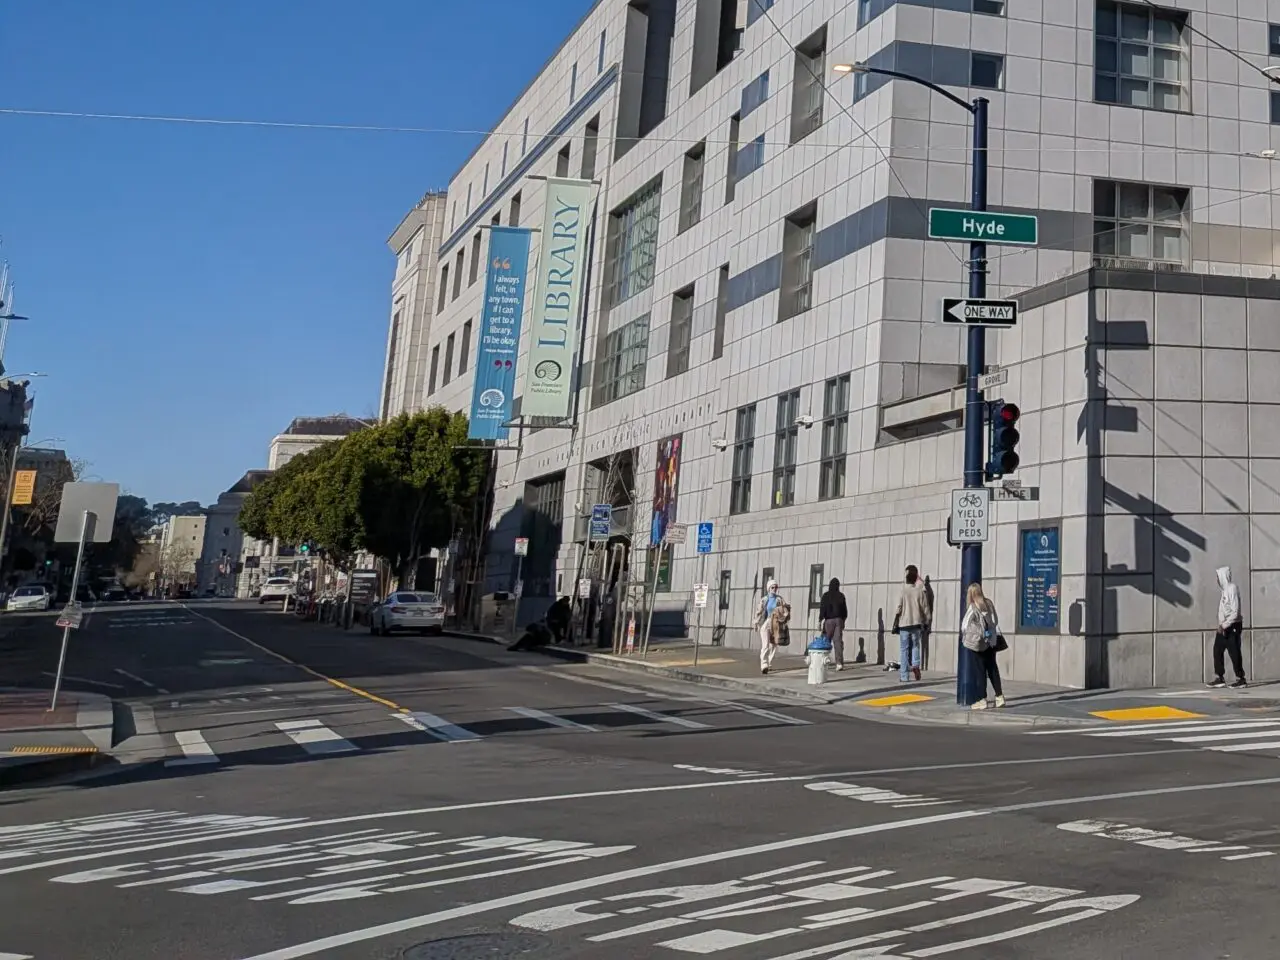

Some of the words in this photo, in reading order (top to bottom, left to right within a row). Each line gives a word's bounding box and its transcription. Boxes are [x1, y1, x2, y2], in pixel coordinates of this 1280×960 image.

[962, 218, 1005, 237] Hyde
[538, 195, 580, 350] LIBRARY
[497, 276, 520, 286] always
[496, 285, 508, 294] felt,
[488, 296, 501, 304] any
[501, 296, 520, 305] town,
[502, 306, 514, 314] can
[964, 306, 986, 318] ONE
[988, 306, 1011, 318] WAY
[489, 317, 501, 325] get
[502, 317, 510, 325] to
[491, 336, 500, 344] be
[500, 336, 516, 346] okay.
[998, 489, 1026, 500] HYDE
[957, 509, 984, 518] YIELD
[964, 519, 976, 528] TO
[958, 529, 982, 537] PEDS
